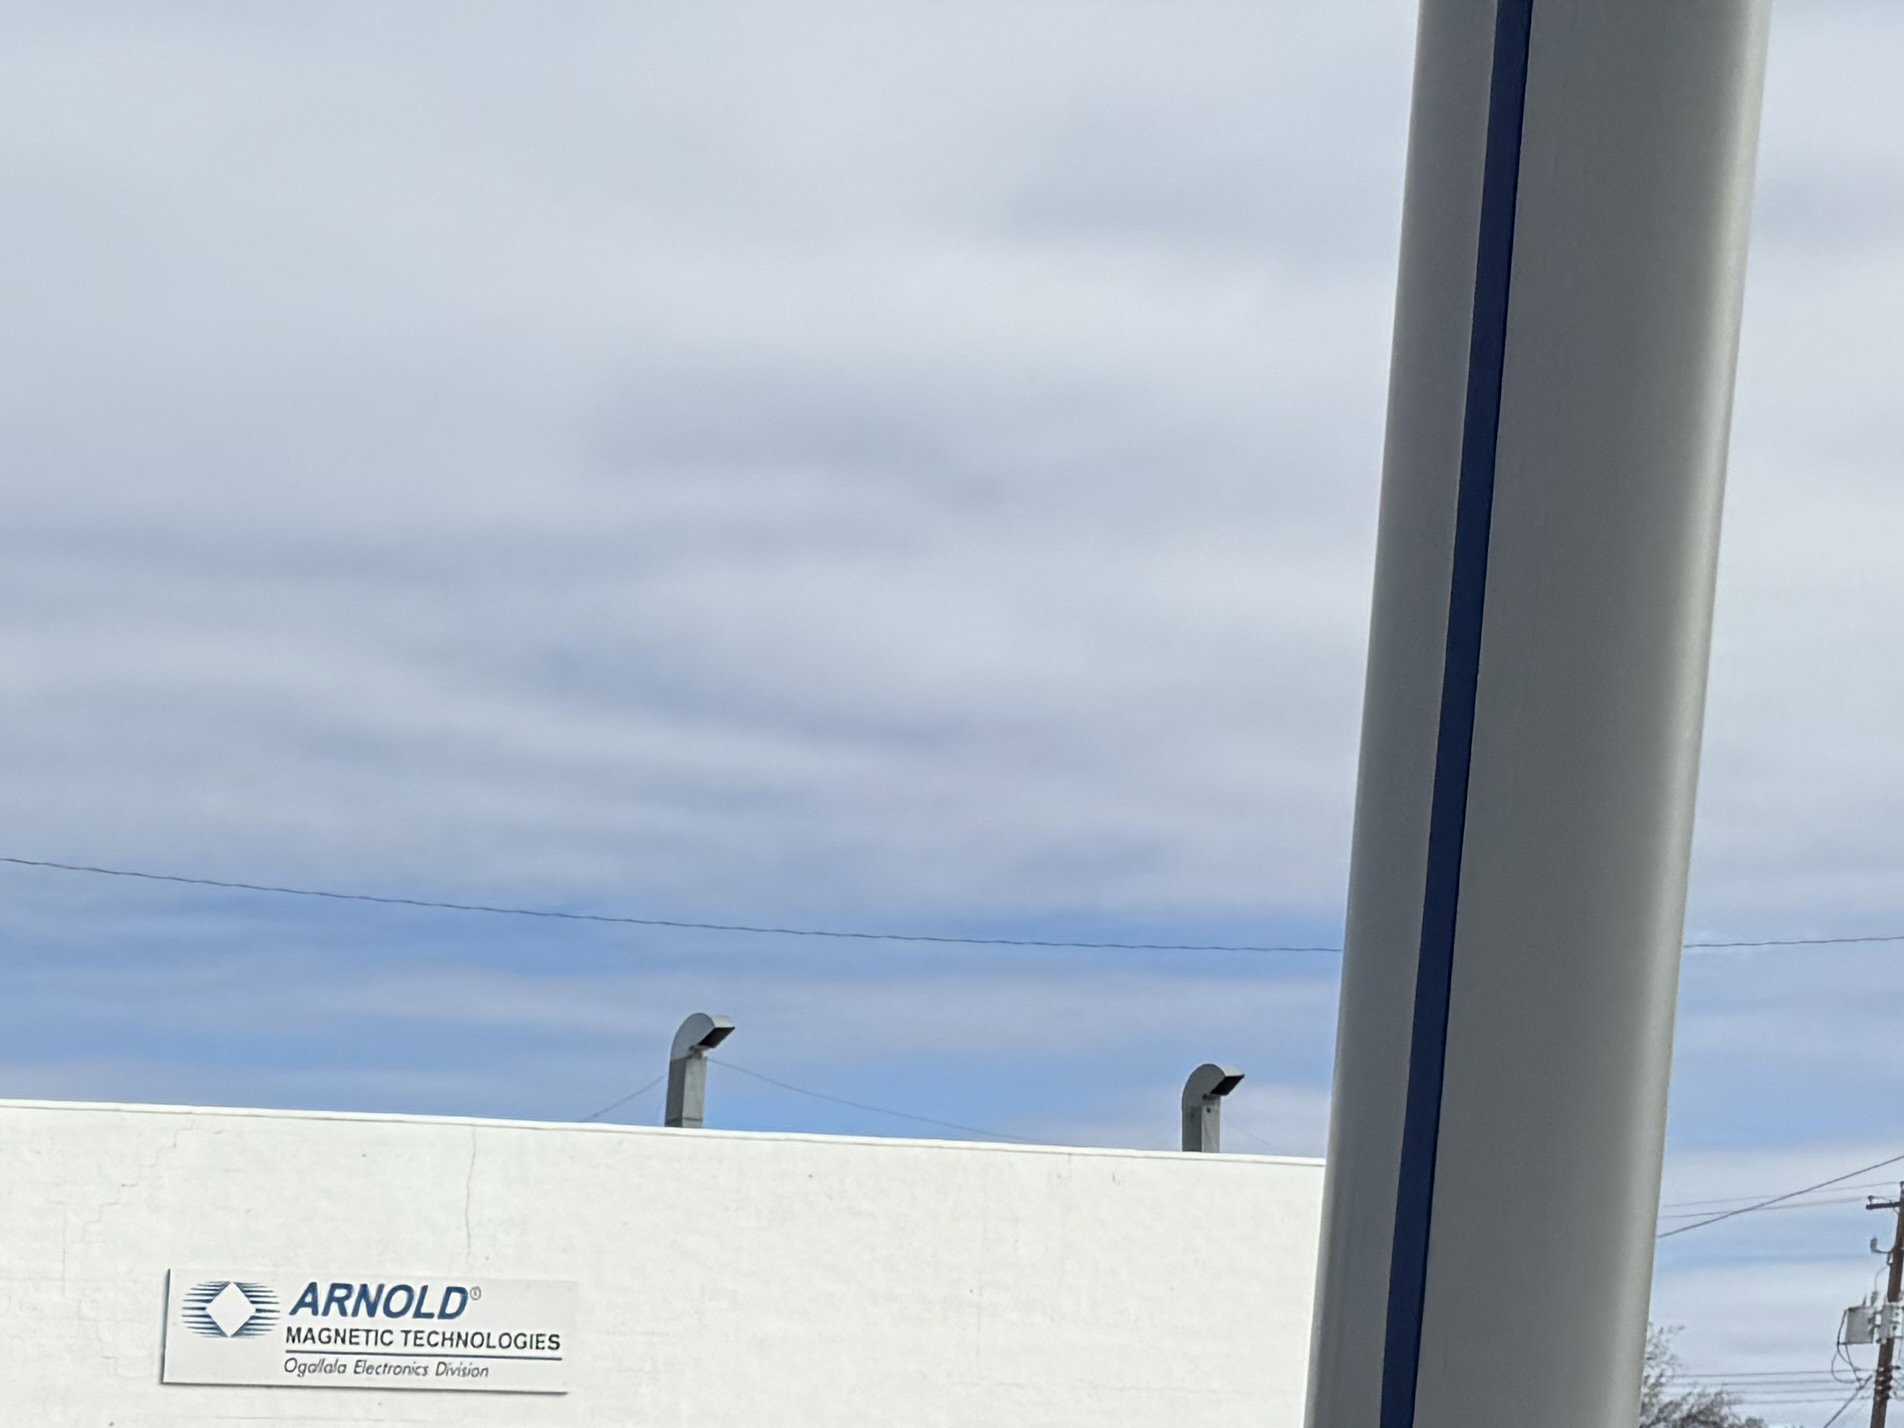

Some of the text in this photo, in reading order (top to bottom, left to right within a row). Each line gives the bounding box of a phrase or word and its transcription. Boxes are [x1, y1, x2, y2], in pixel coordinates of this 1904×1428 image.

[285, 1326, 561, 1351] MAGNETIC TECHNOLOGIES
[354, 1359, 429, 1377] Electronics
[435, 1362, 490, 1379] Division
